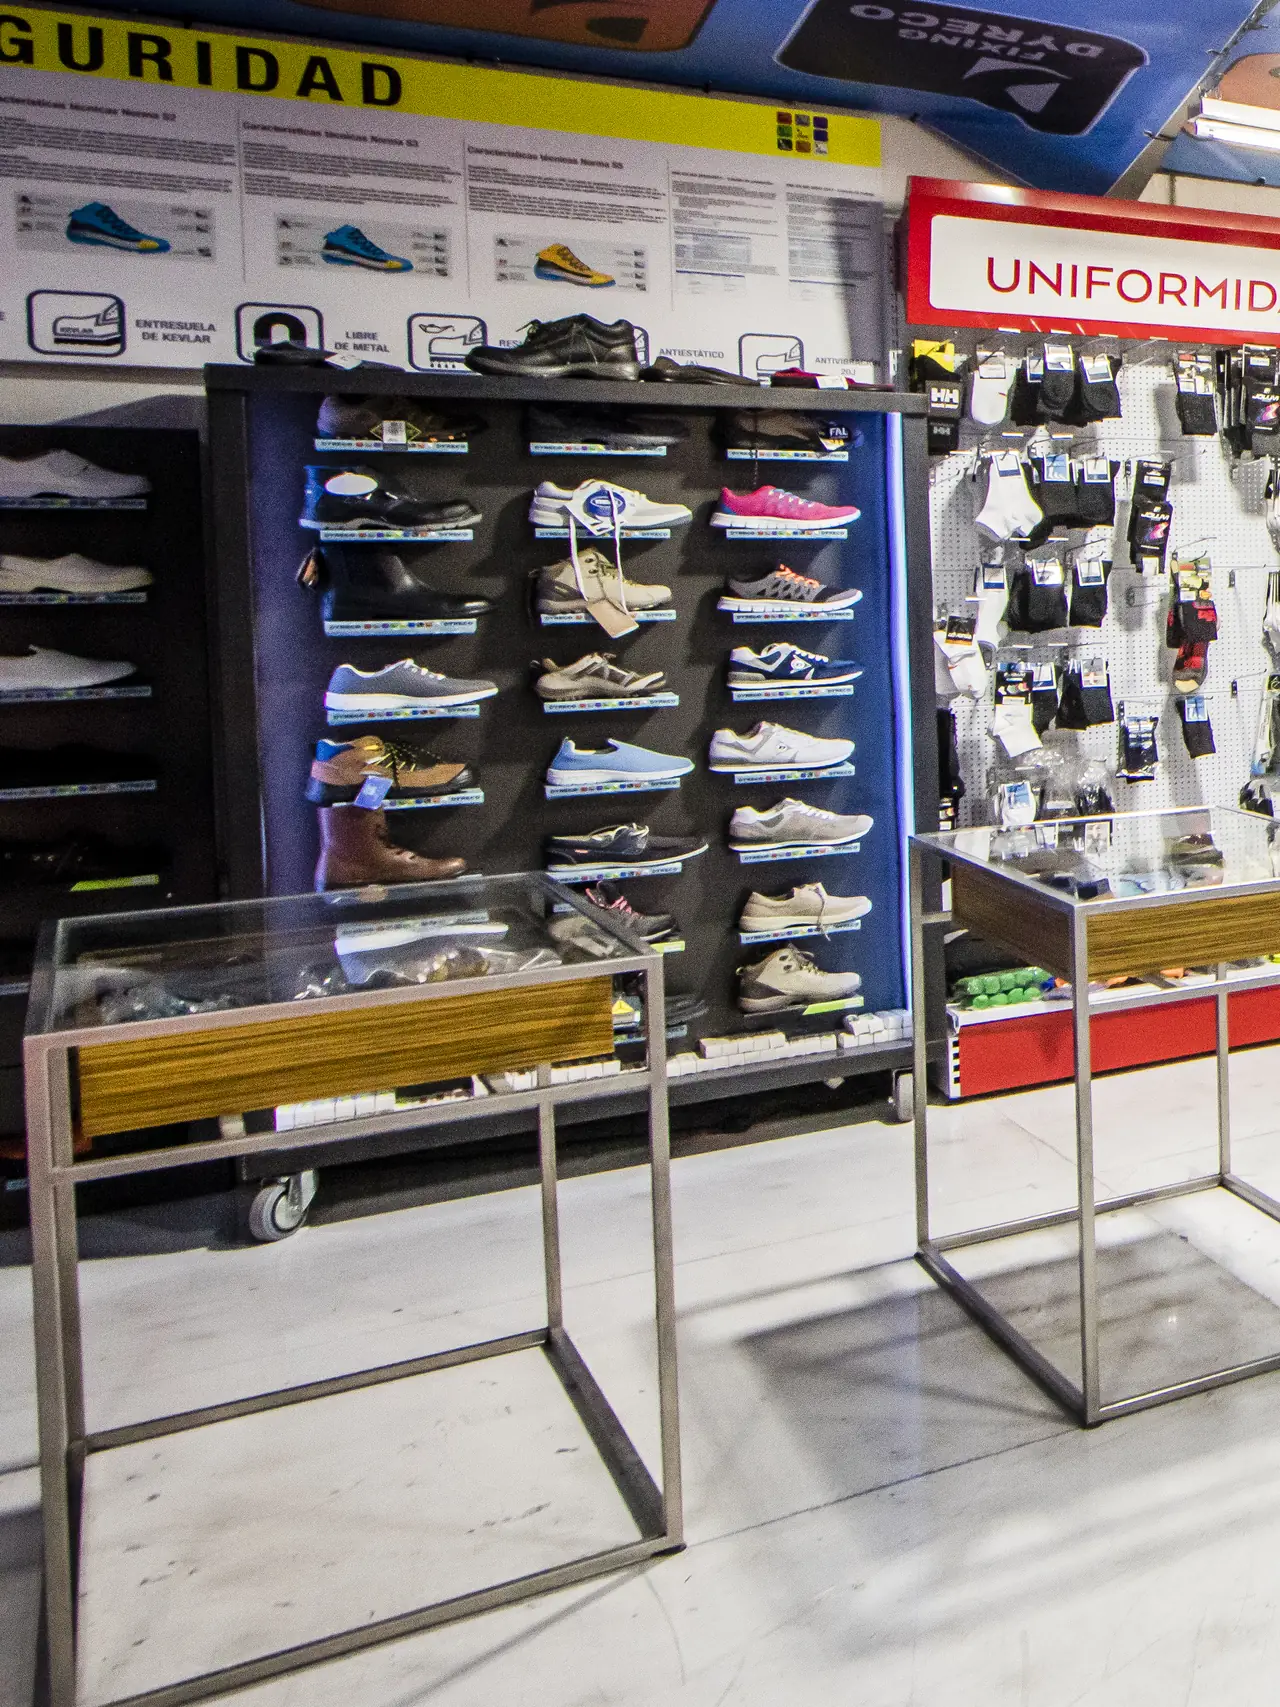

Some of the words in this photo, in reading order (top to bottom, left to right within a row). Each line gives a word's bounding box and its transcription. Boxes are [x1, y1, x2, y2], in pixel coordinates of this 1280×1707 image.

[850, 4, 1104, 58] DYRECO
[898, 28, 1048, 62] FIXING
[0, 15, 402, 106] GURIDAD
[987, 256, 1280, 313] UNIFORMID
[135, 319, 216, 332] ENTRESUELA
[142, 332, 158, 341] DE
[162, 333, 211, 343] KEVLAR
[345, 331, 379, 341] LIBRE
[334, 342, 349, 351] DE
[353, 343, 390, 353] METAL
[829, 427, 849, 437] FAL
